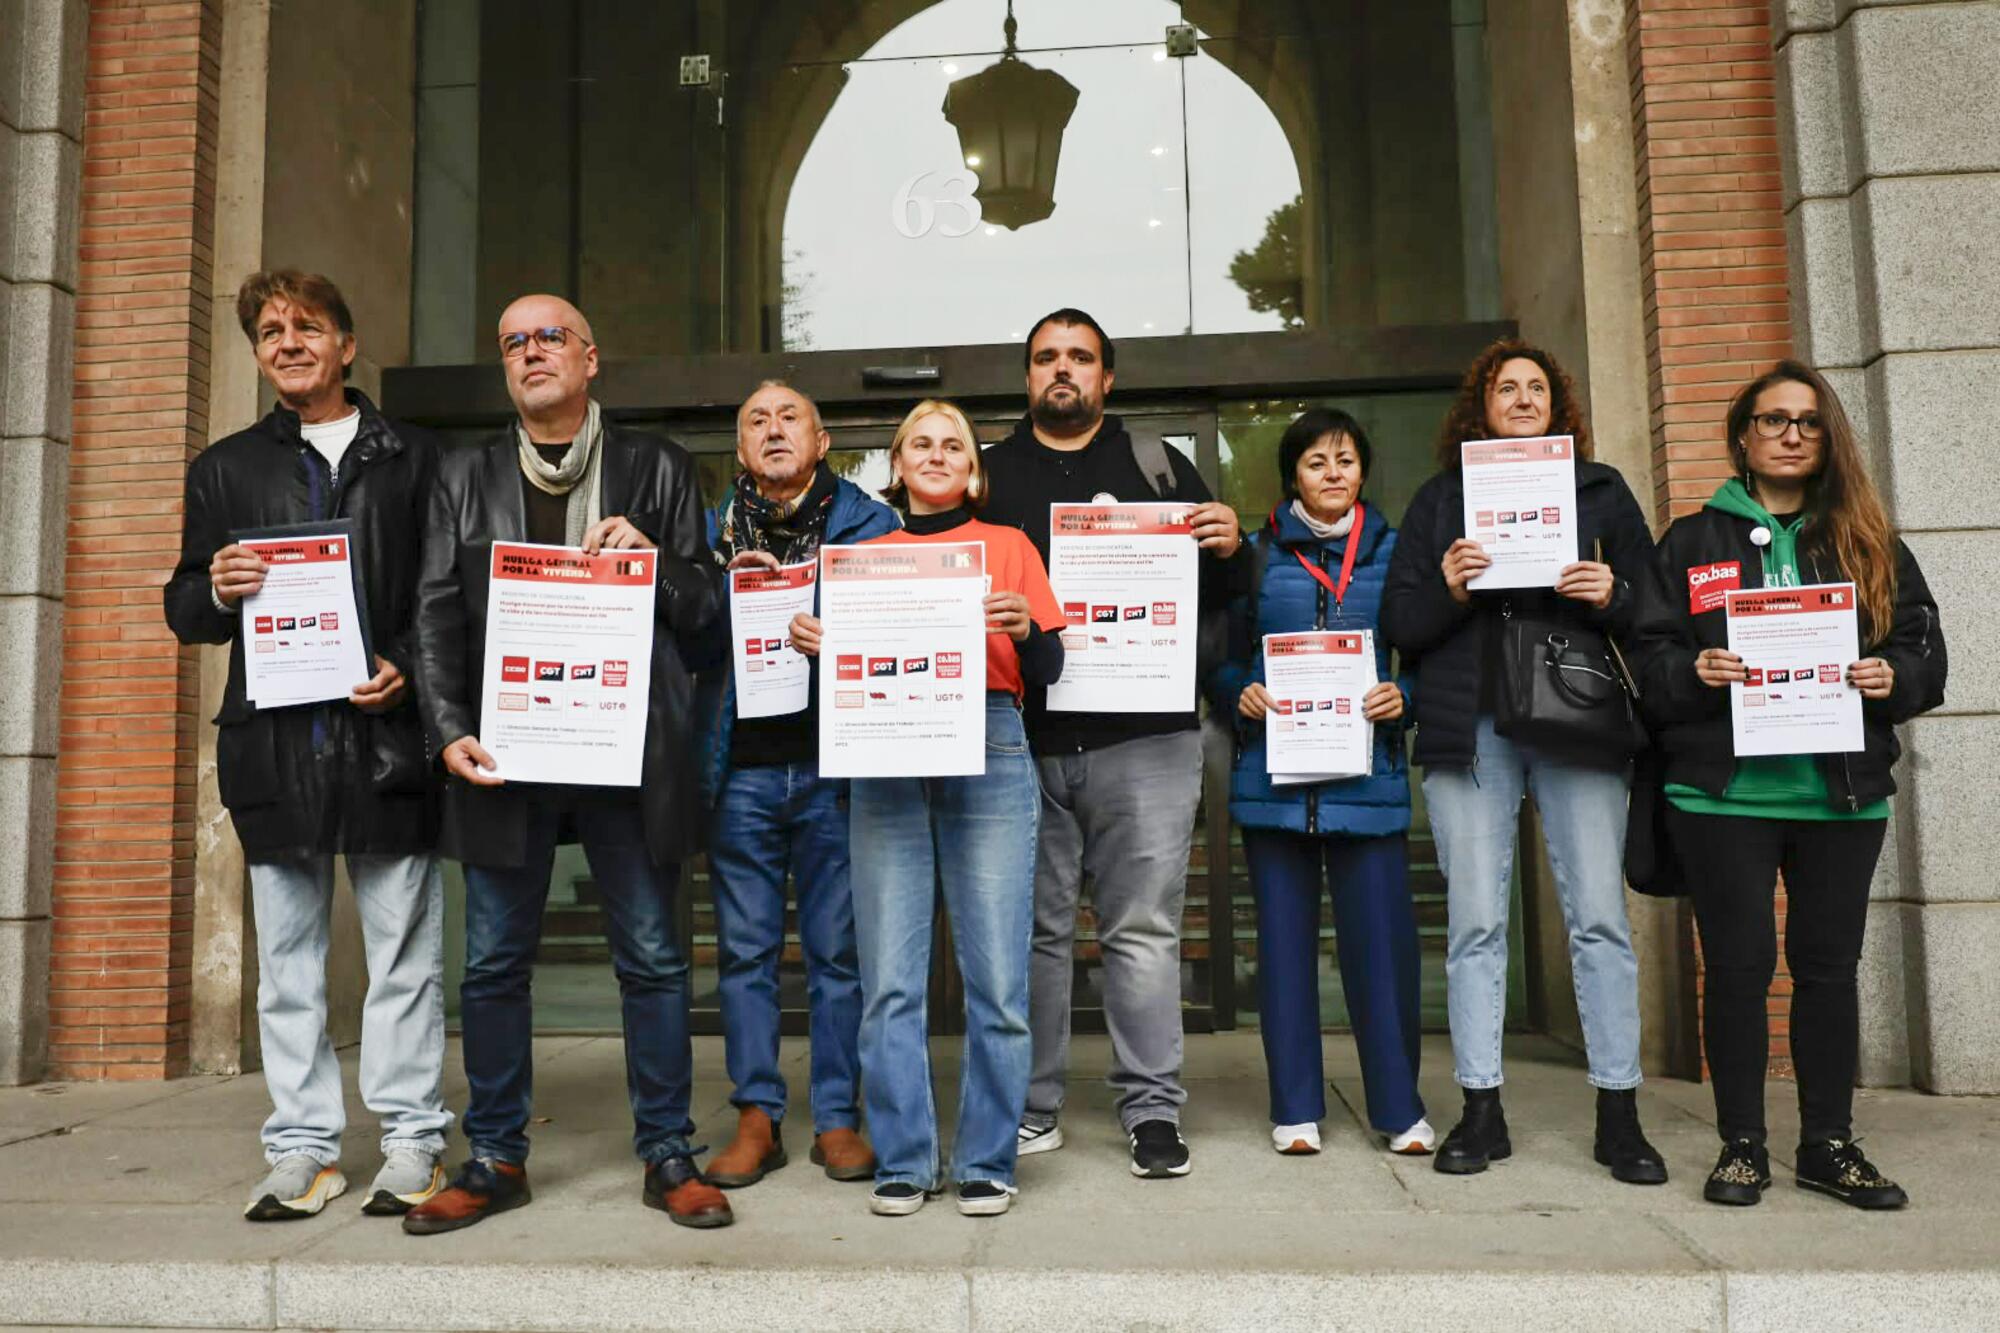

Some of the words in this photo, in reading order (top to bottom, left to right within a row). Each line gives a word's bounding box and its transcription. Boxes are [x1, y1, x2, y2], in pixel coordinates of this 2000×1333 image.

[891, 167, 982, 239] 63
[1060, 514, 1095, 522] HUELGA
[1097, 514, 1137, 522] GENERAL
[1094, 522, 1138, 530] VIVIENDA
[502, 555, 543, 566] HUELGA
[546, 558, 591, 569] GENERAL
[832, 557, 870, 565] HUELGA
[873, 556, 917, 565] GENERAL
[502, 565, 524, 575] POR
[526, 567, 539, 576] LA
[542, 568, 592, 579] VIVIENDA
[832, 567, 852, 575] POR
[854, 567, 866, 575] LA
[870, 565, 918, 575] VIVIENDA
[1690, 565, 1738, 586] co.bas
[1766, 596, 1801, 605] GENERAL
[1764, 603, 1802, 611] VIVIENDA
[1095, 609, 1115, 618] CGT
[1126, 609, 1144, 618] CNT
[1151, 638, 1169, 647] UGT
[873, 662, 893, 671] CGT
[906, 661, 926, 670] CNT
[539, 666, 562, 677] CGT
[573, 668, 594, 677] CNT
[1796, 671, 1812, 679] CNT
[935, 693, 954, 702] UGT
[599, 700, 618, 711] UGT
